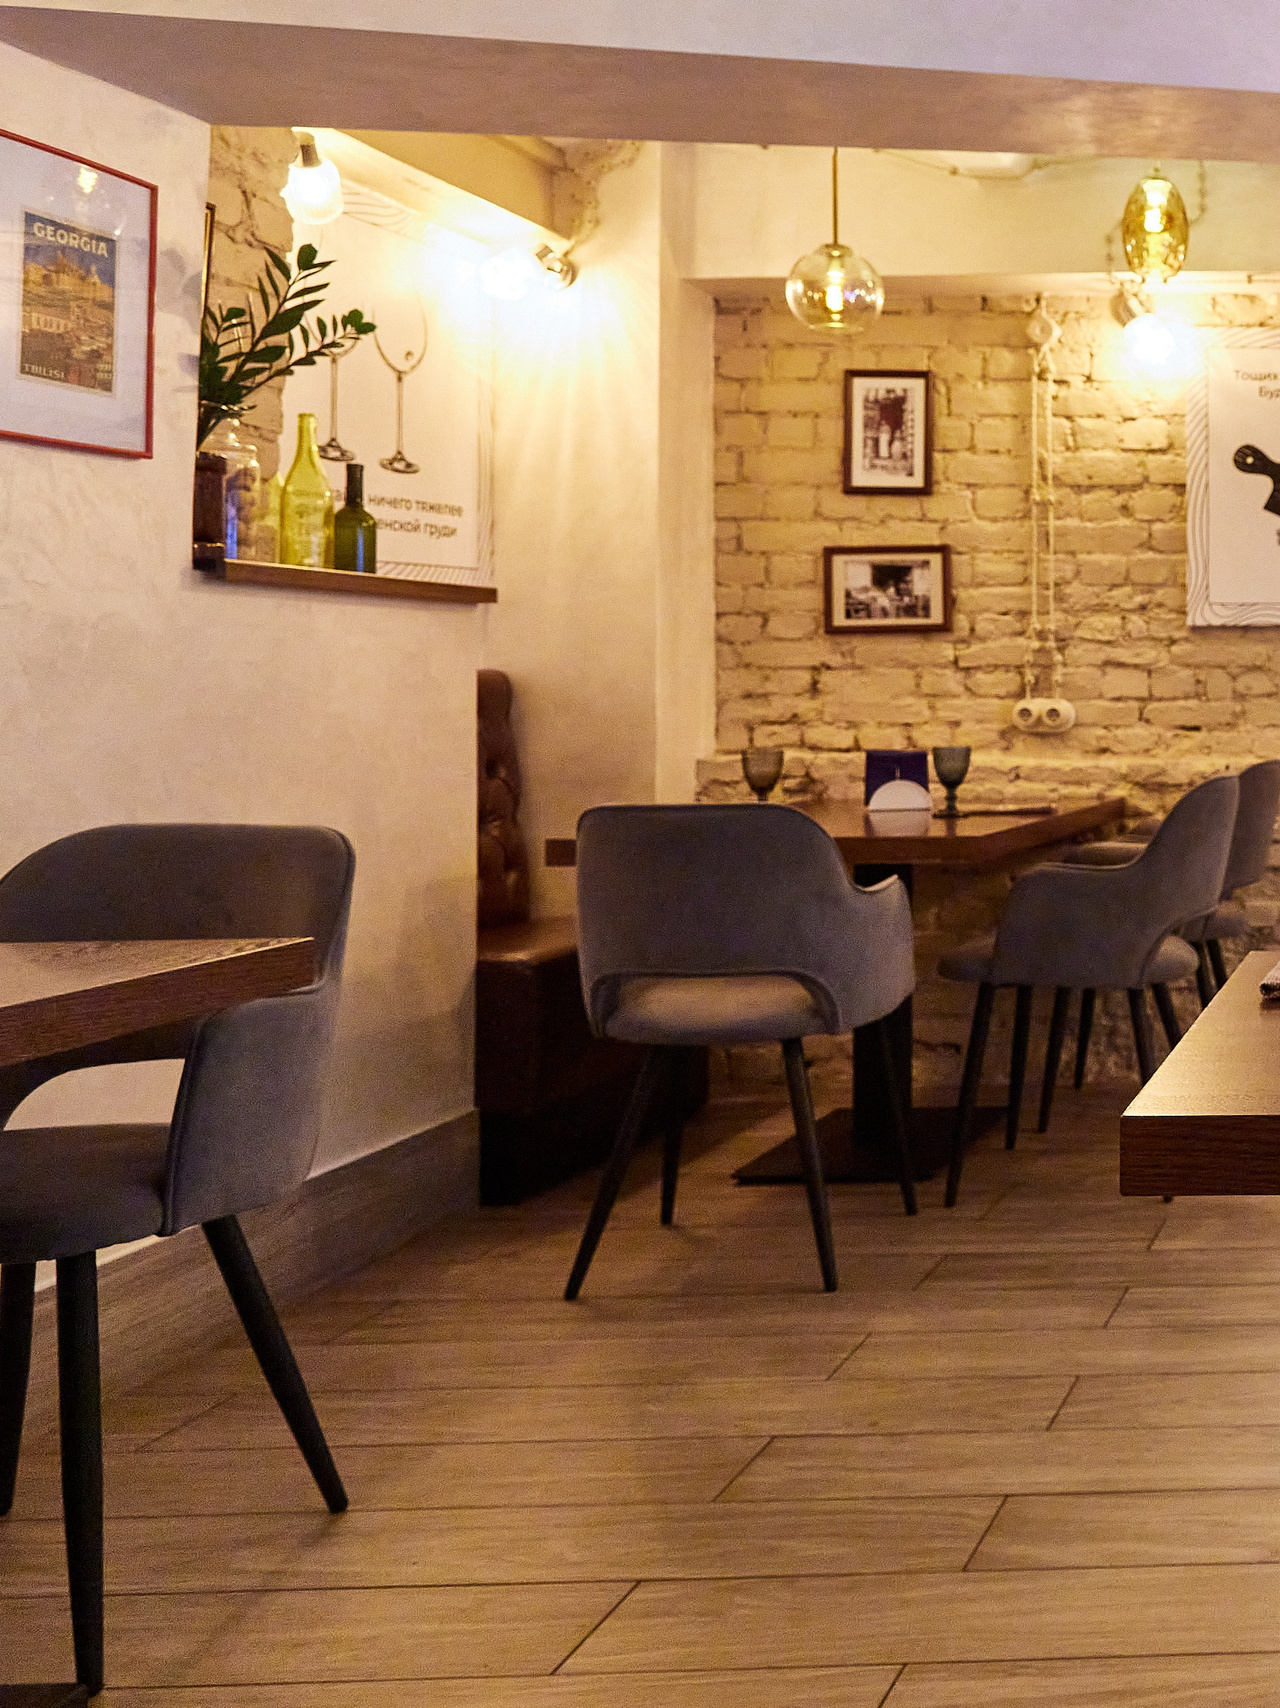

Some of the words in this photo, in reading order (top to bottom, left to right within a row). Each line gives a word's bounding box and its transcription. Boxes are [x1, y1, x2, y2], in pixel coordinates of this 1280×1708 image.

[33, 222, 108, 258] GEORGIA
[368, 493, 413, 511] ничего
[415, 499, 464, 517] тяжелее
[377, 517, 421, 534] енской
[423, 520, 458, 539] груди
